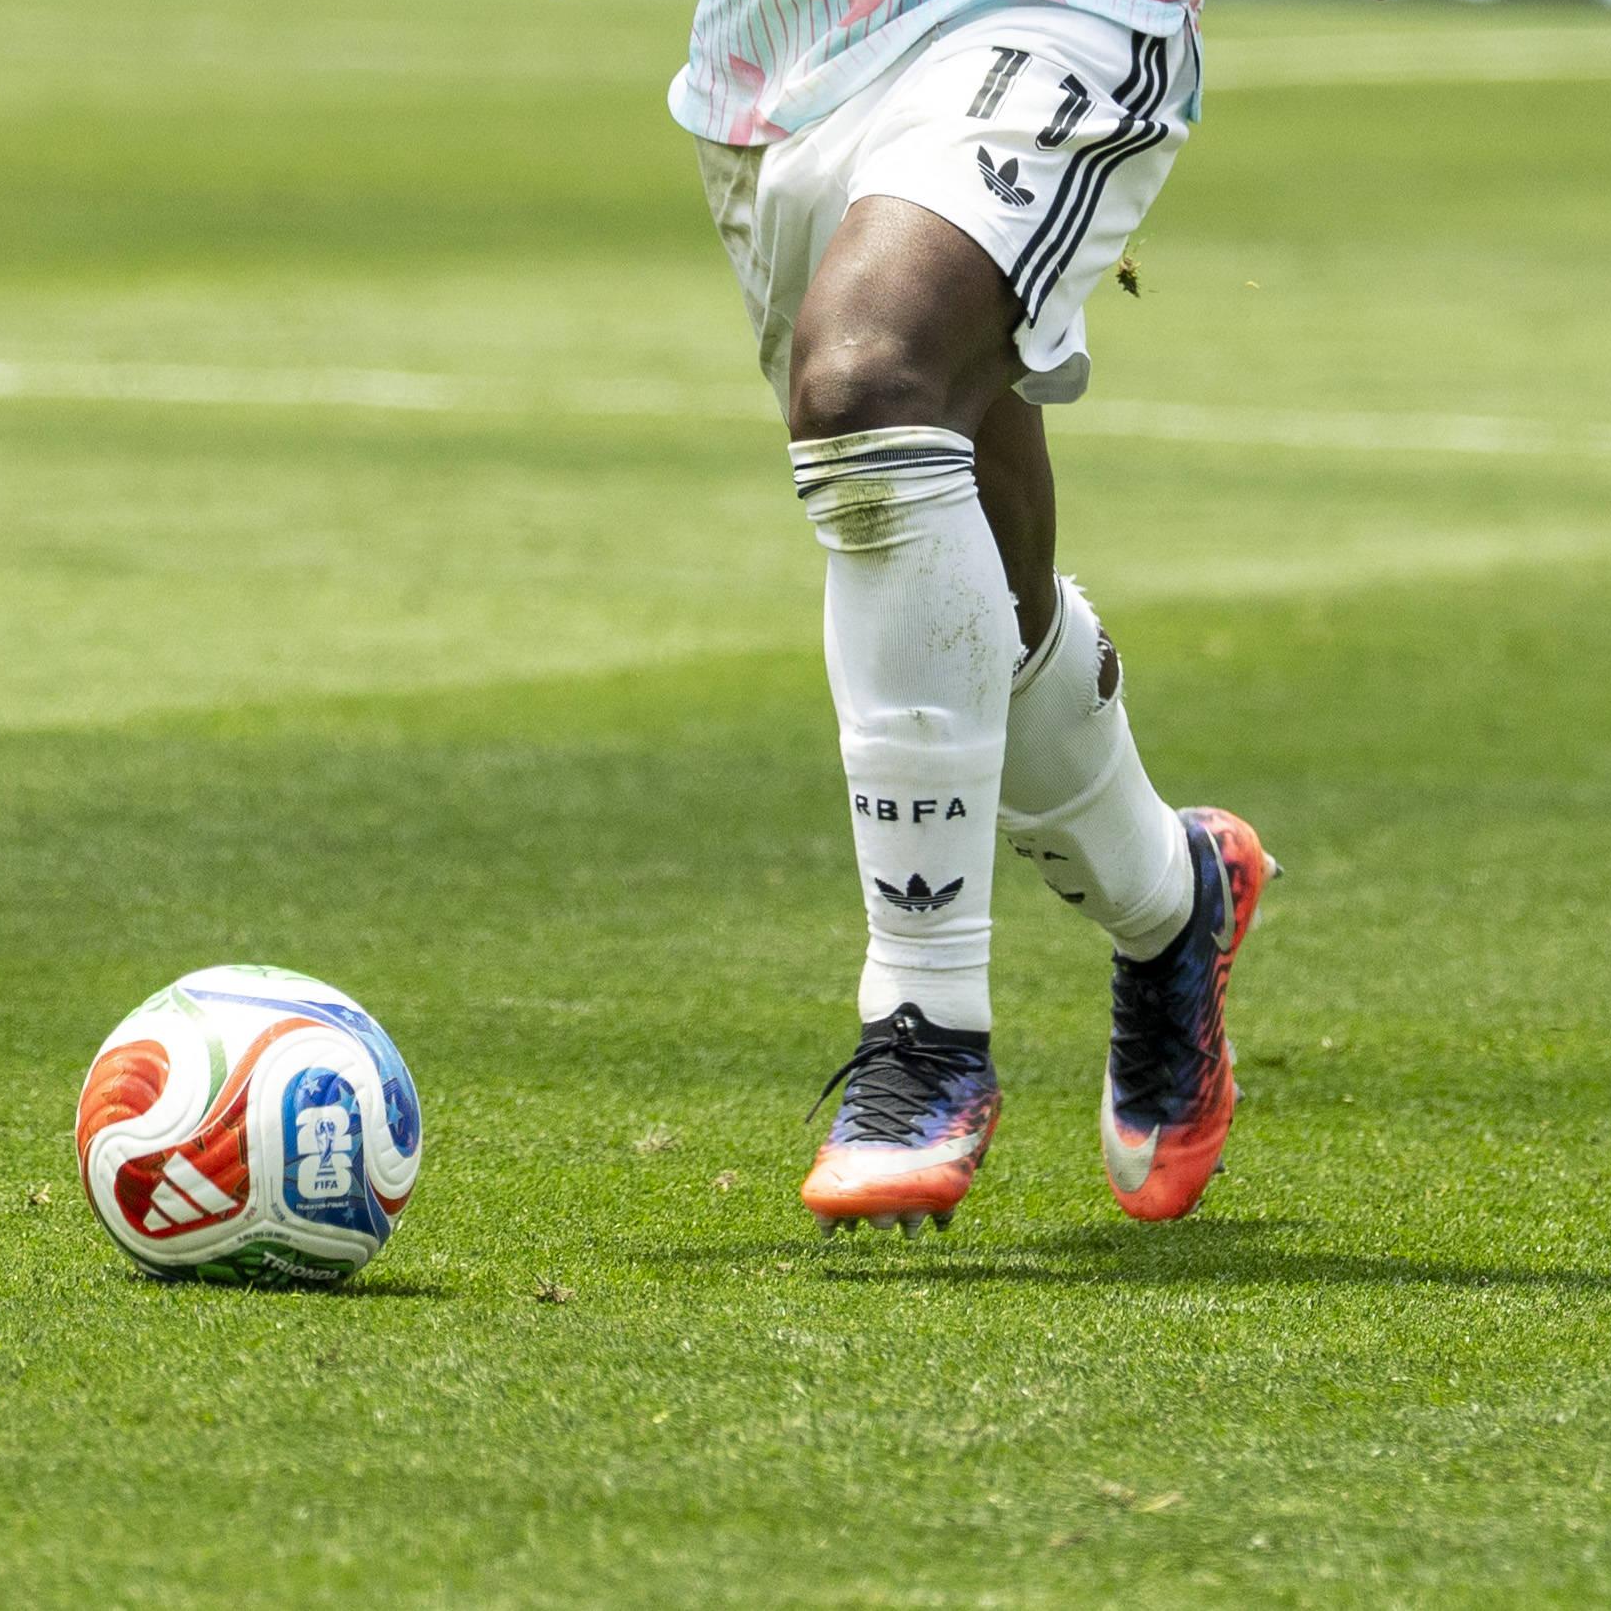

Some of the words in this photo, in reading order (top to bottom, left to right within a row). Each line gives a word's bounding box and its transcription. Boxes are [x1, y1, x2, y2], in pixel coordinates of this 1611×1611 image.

[966, 46, 1097, 151] 11
[855, 794, 966, 823] RBFA
[314, 1181, 338, 1190] FIFA
[262, 1250, 338, 1280] TRIONDA
